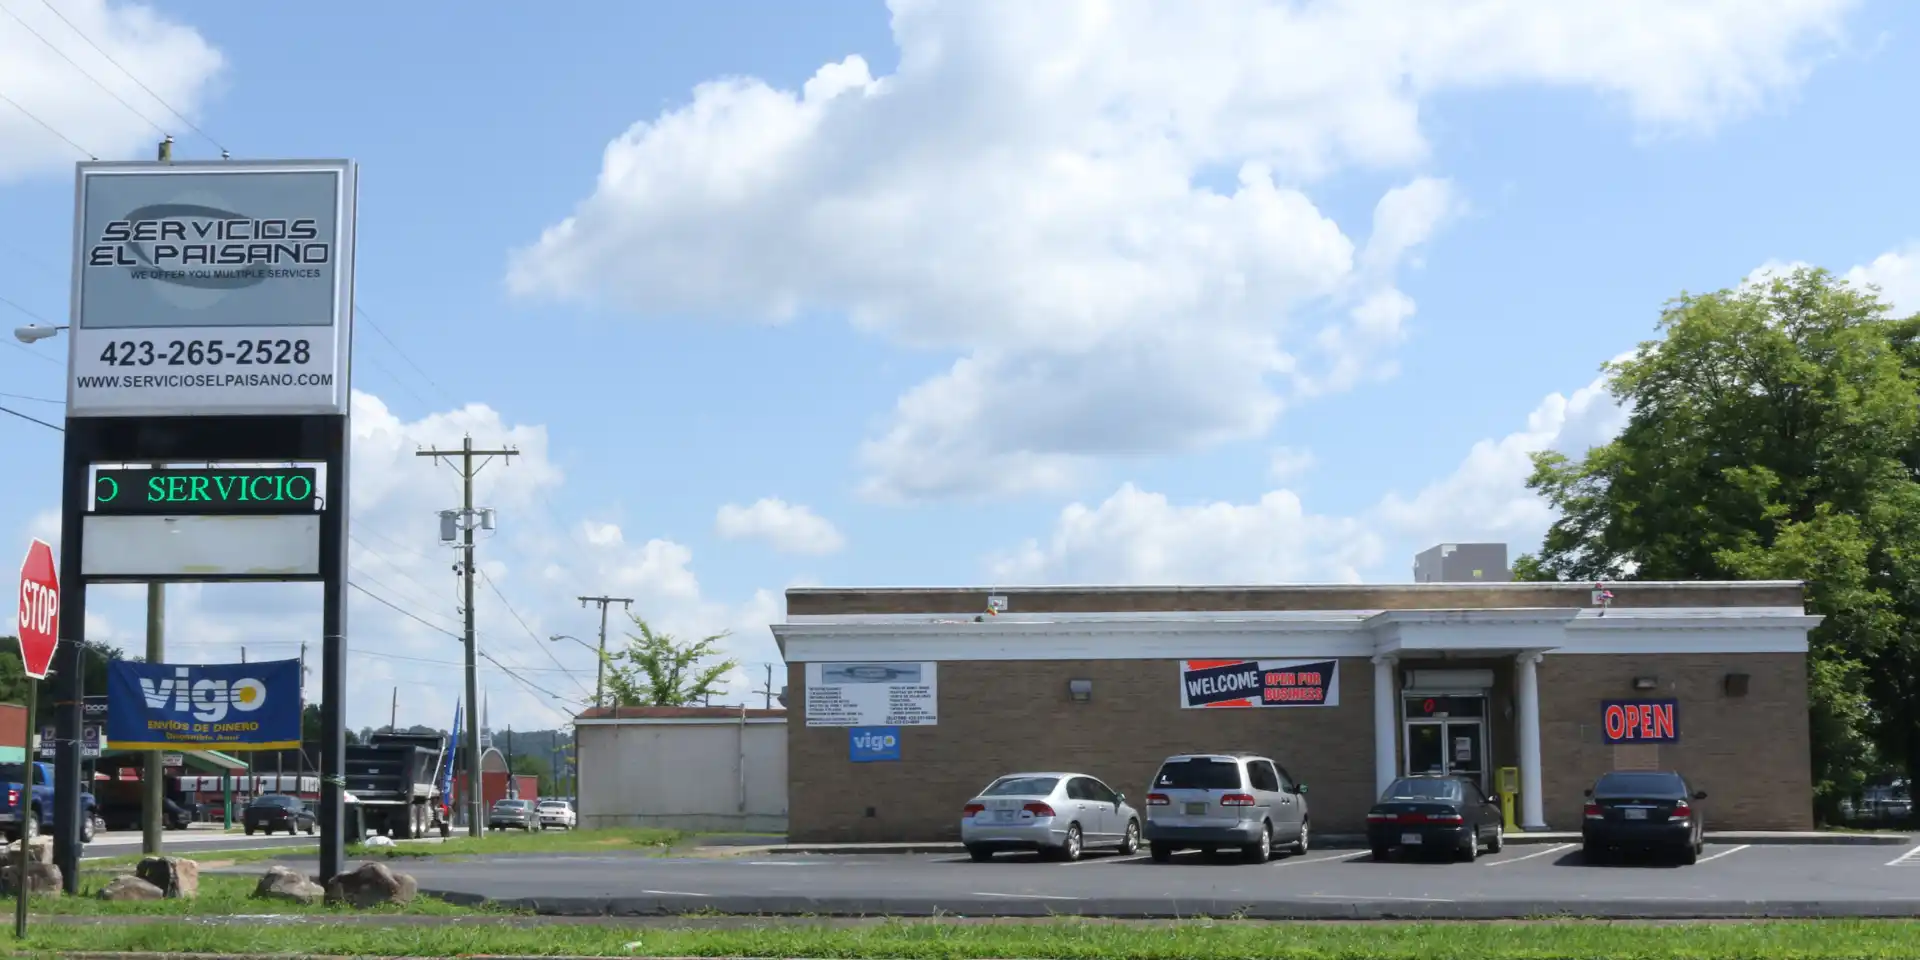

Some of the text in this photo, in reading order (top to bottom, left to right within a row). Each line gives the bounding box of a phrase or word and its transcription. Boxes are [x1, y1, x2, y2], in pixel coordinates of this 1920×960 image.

[101, 219, 318, 242] SERVICIOS
[89, 243, 329, 266] EL PAISANO
[131, 269, 321, 280] WE OFFER YOU MULTIPLE SERVICES
[100, 339, 311, 366] 423-265-2528
[77, 374, 334, 388] WWW.SERVICIOSELPAISANO.COM
[147, 475, 312, 502] SERVICIO
[20, 578, 57, 634] STOP
[1188, 670, 1260, 697] WELCOME
[1265, 672, 1321, 686] OPEN FOR
[139, 667, 267, 722] vigo
[1264, 687, 1323, 701] BUSINESS
[193, 723, 210, 732] DE
[213, 722, 259, 732] DINERO
[1605, 704, 1675, 740] OPEN
[853, 732, 896, 751] vigo
